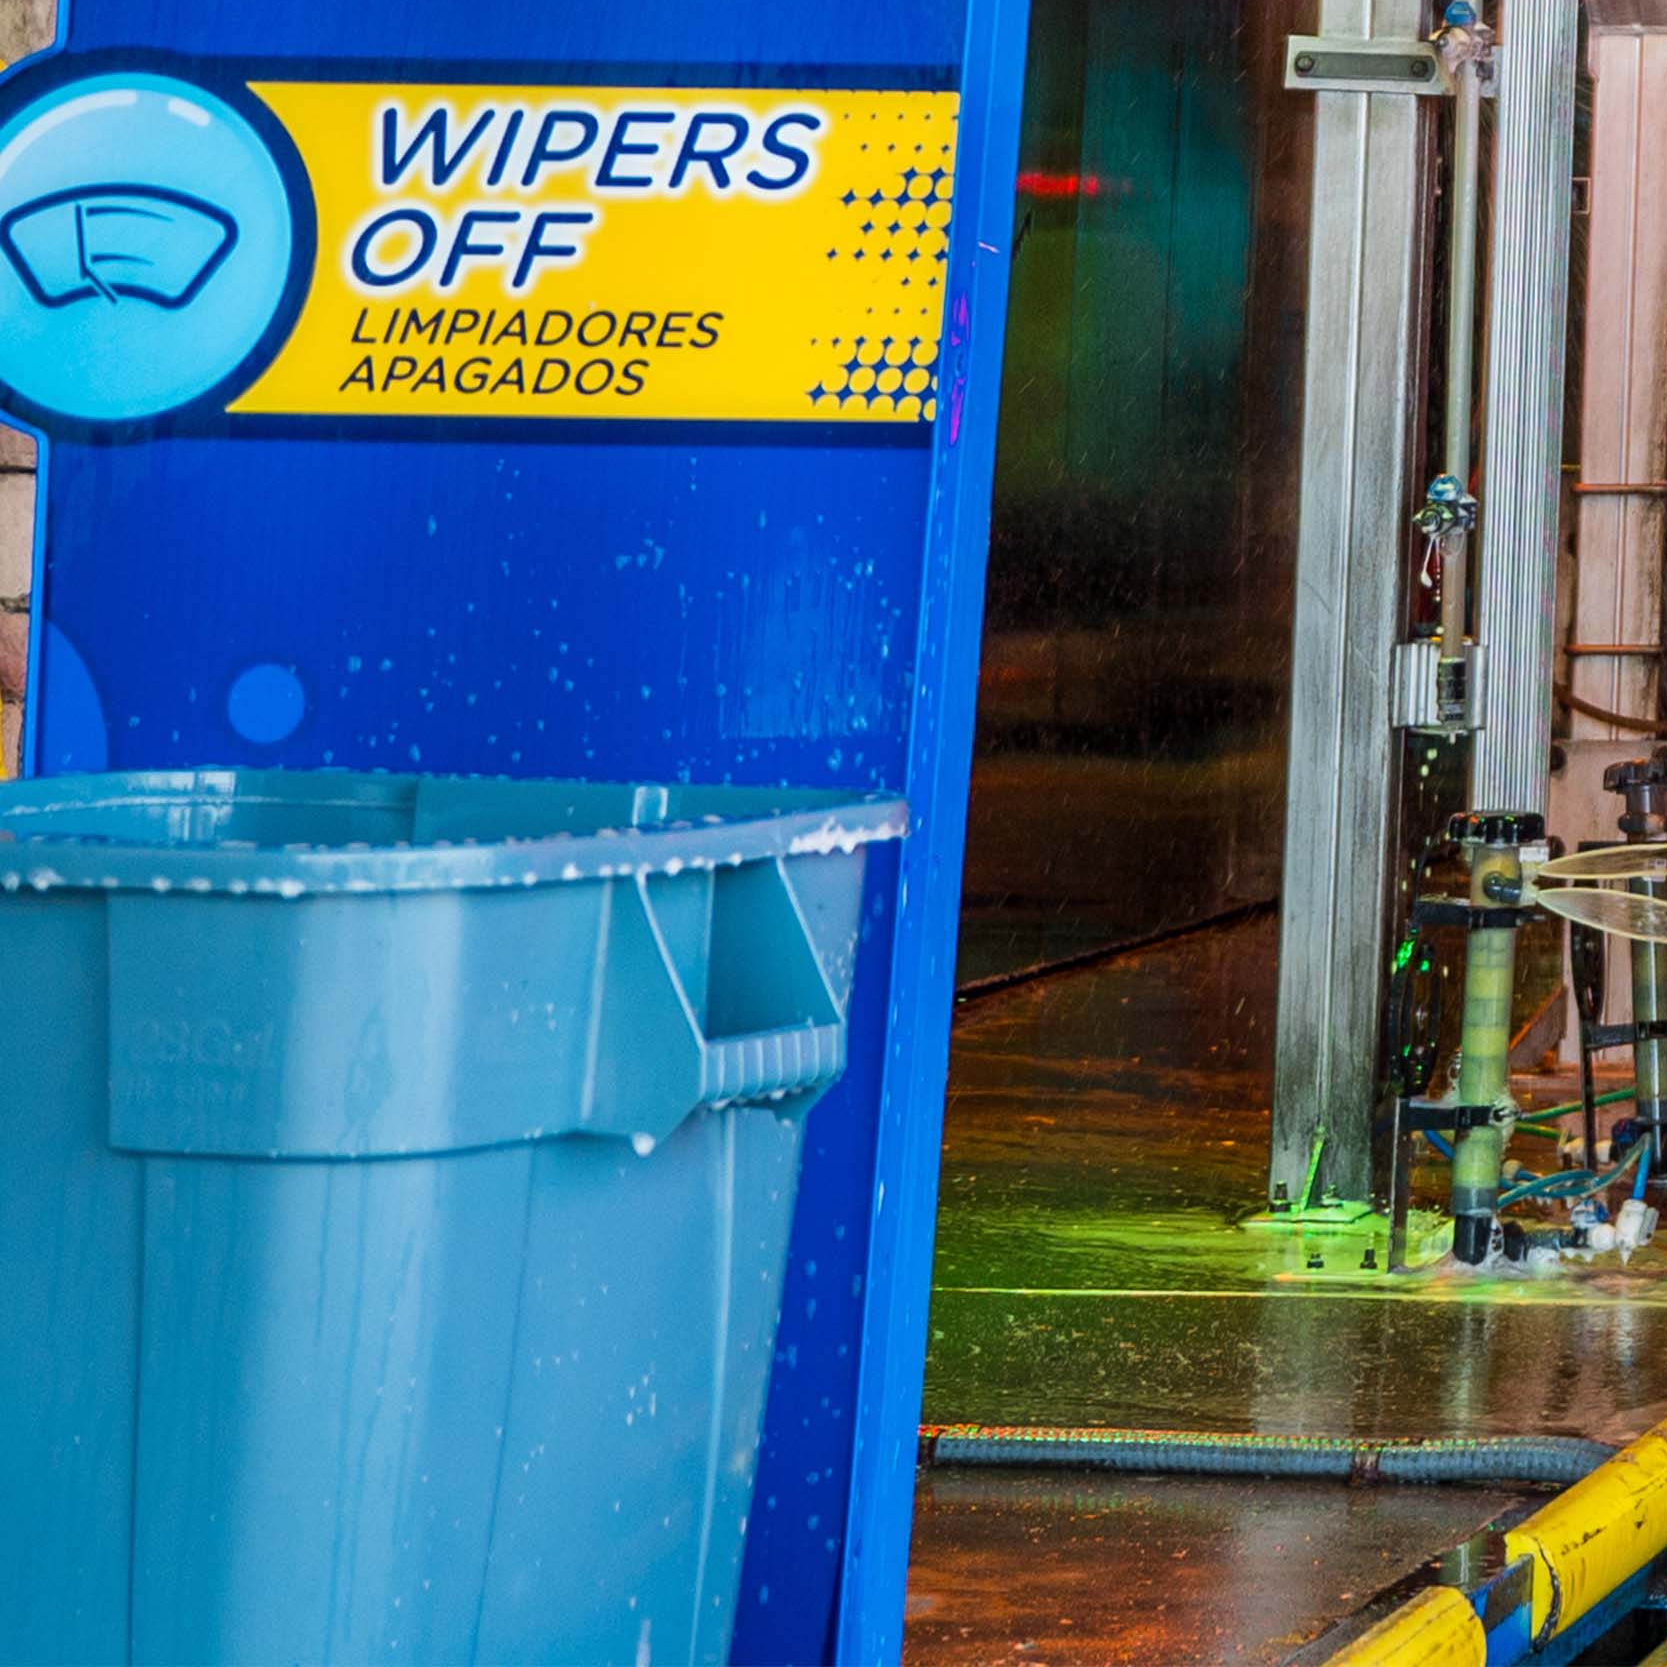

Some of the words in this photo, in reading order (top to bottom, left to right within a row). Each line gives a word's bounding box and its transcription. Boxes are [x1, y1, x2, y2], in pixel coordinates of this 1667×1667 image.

[381, 106, 822, 191] WIPERS
[350, 207, 595, 289] OFF
[350, 307, 725, 350] LIMPIADORES
[338, 354, 651, 397] APAGADOS
